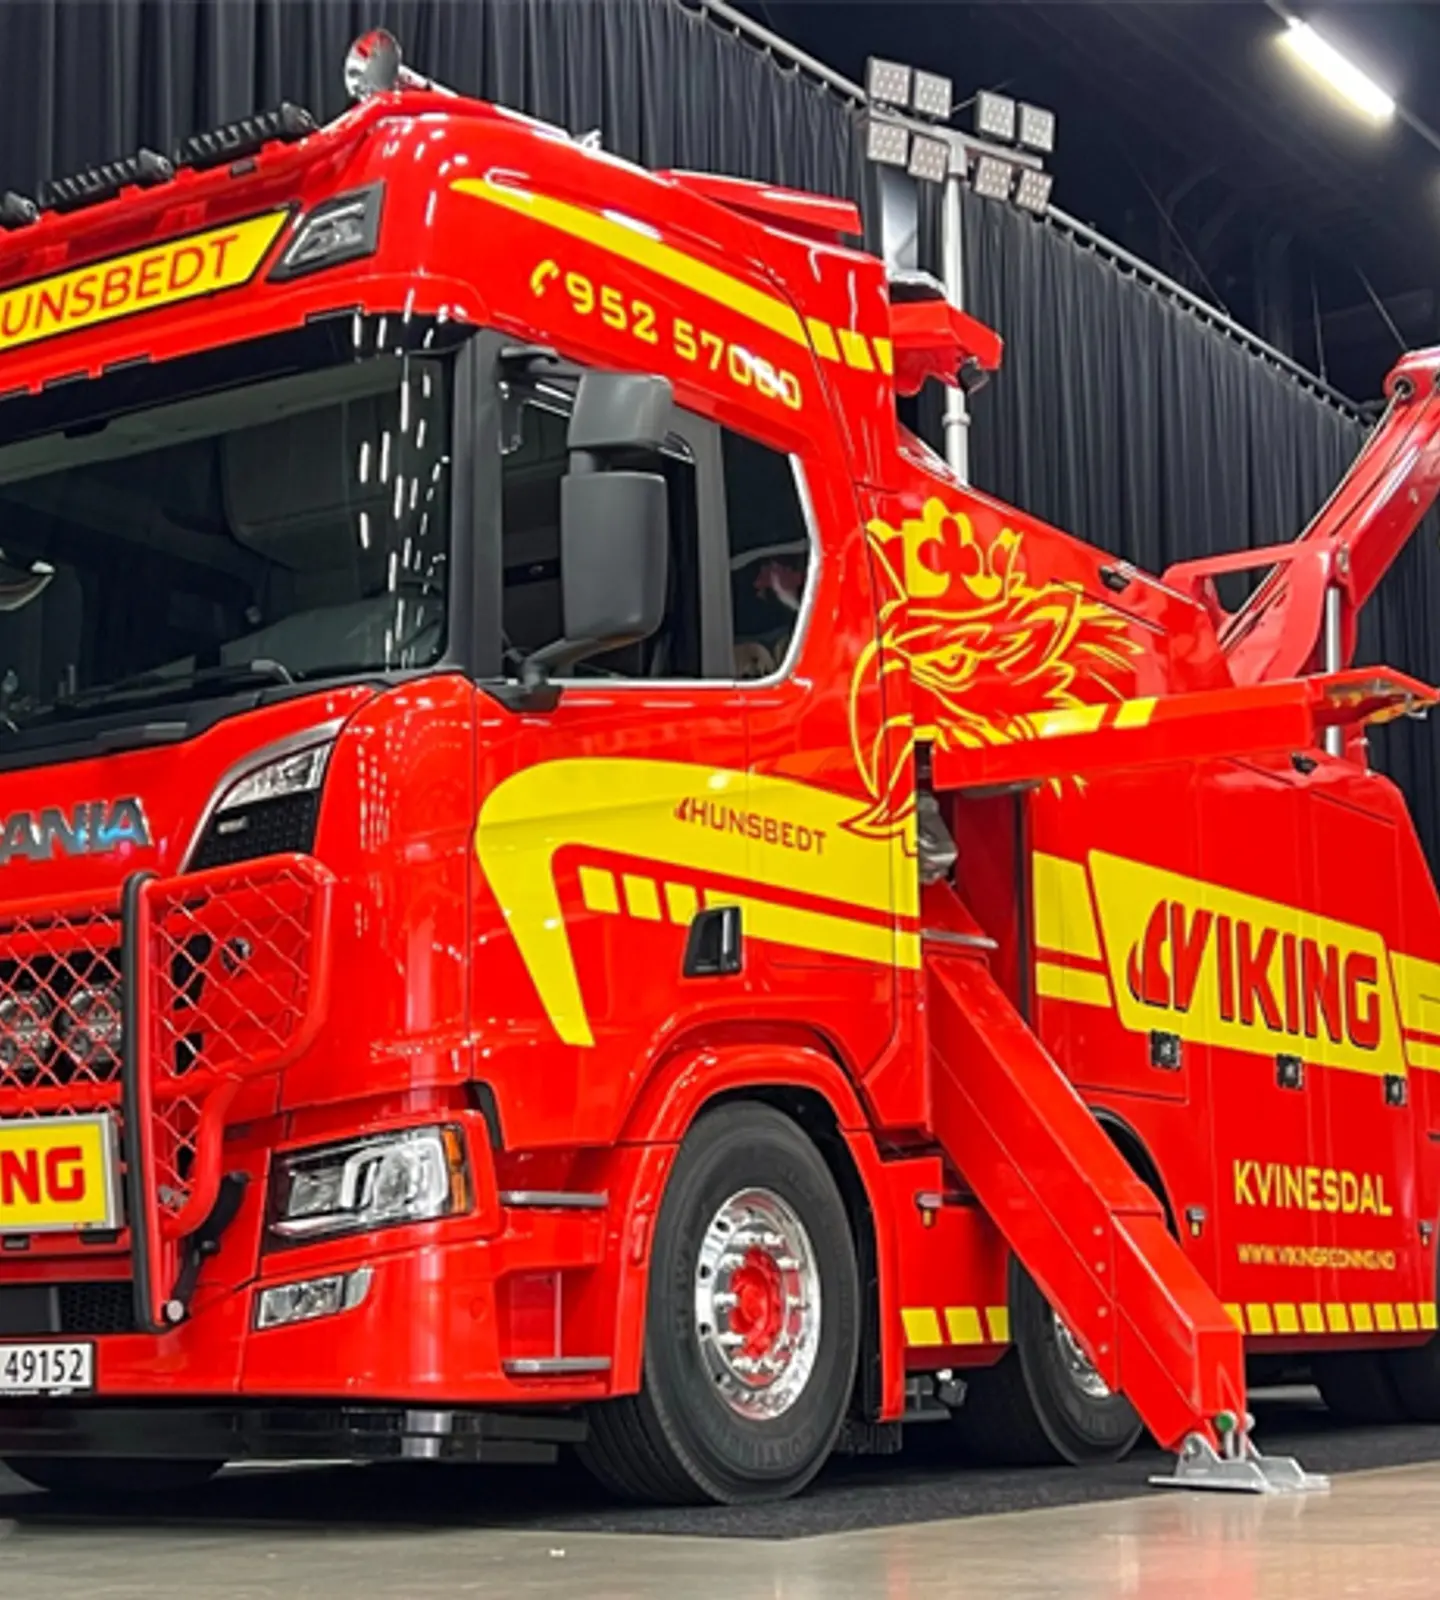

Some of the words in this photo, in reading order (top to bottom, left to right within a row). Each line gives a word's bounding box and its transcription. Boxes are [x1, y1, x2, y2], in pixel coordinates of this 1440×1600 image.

[1, 234, 239, 338] UNSBEDT
[565, 271, 659, 345] 952
[0, 797, 154, 865] ANIA
[689, 797, 827, 855] HUNSBEDT
[1170, 901, 1381, 1051] VIKING
[0, 1146, 85, 1205] NG
[1233, 1159, 1393, 1216] KVINESDAL
[4, 1349, 84, 1382] 49152
